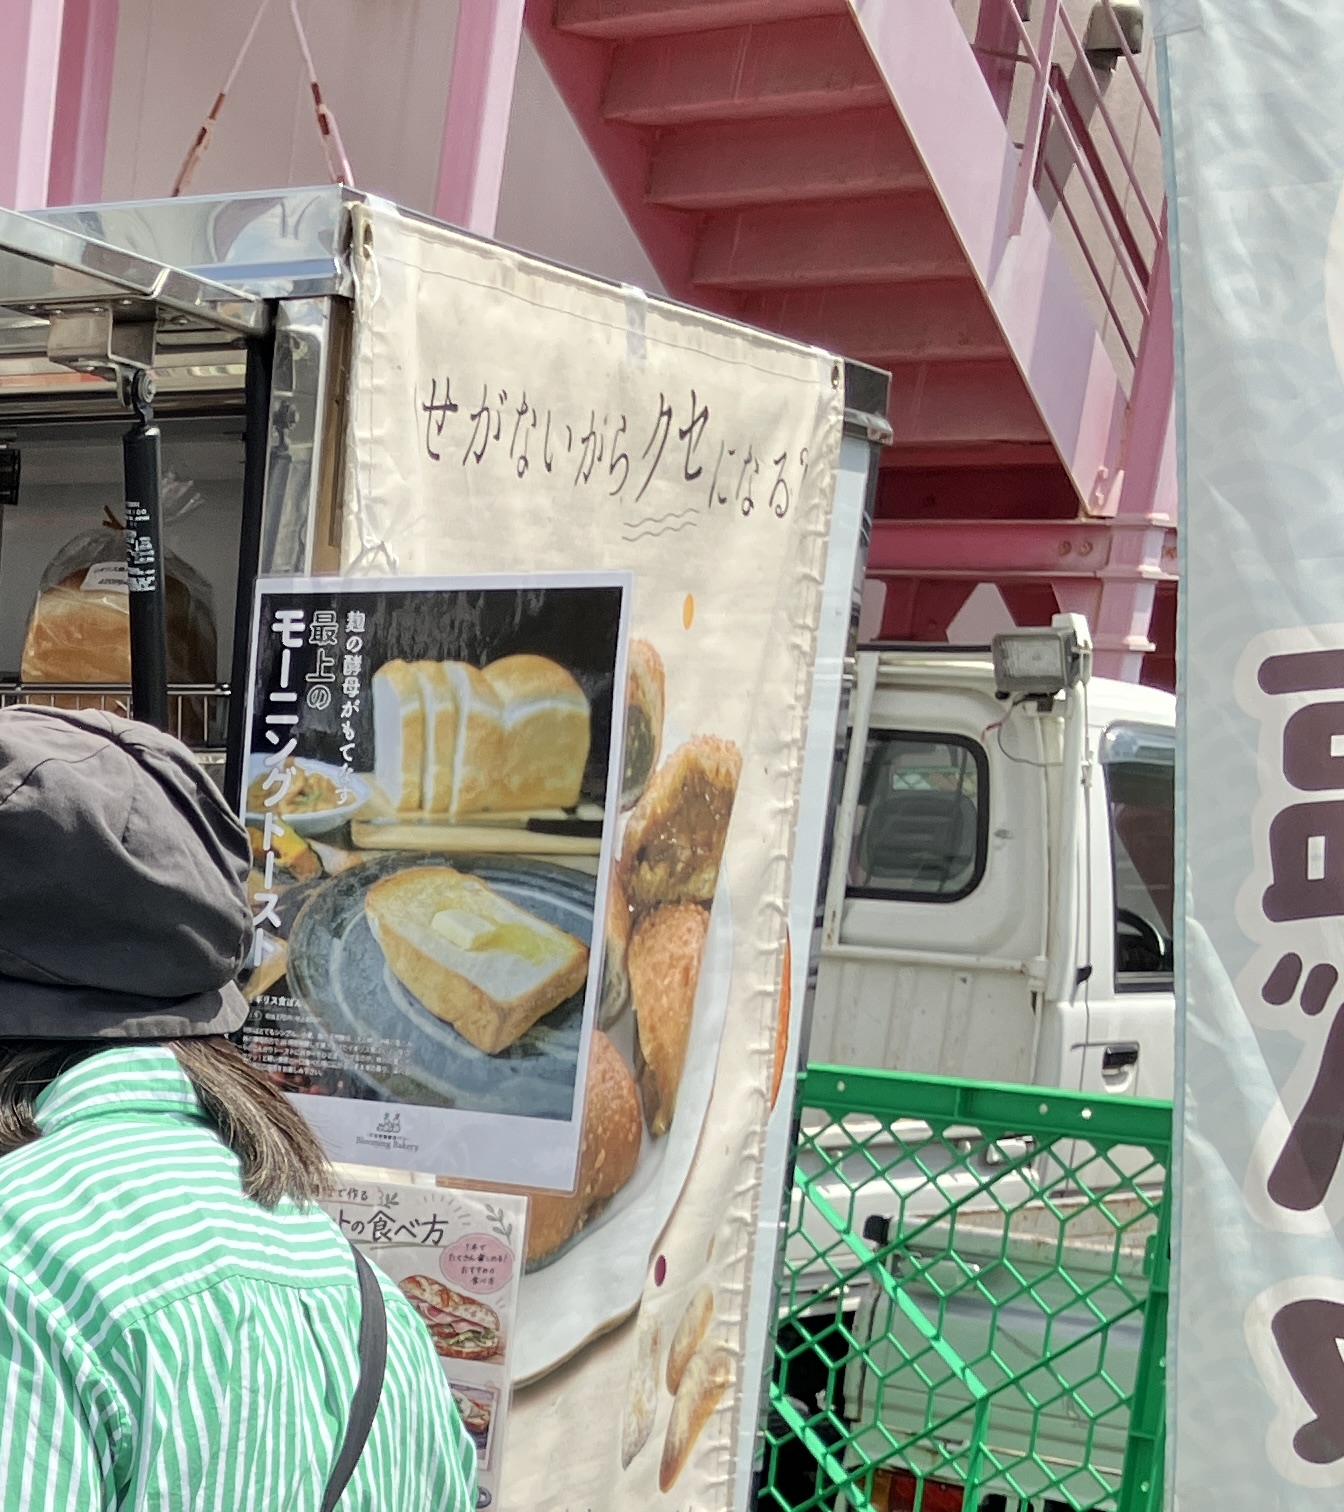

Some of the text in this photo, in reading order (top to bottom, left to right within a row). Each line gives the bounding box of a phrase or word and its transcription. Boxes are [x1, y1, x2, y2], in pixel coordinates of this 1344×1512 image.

[305, 610, 339, 712] 最上の
[252, 609, 306, 968] モーニングトースト
